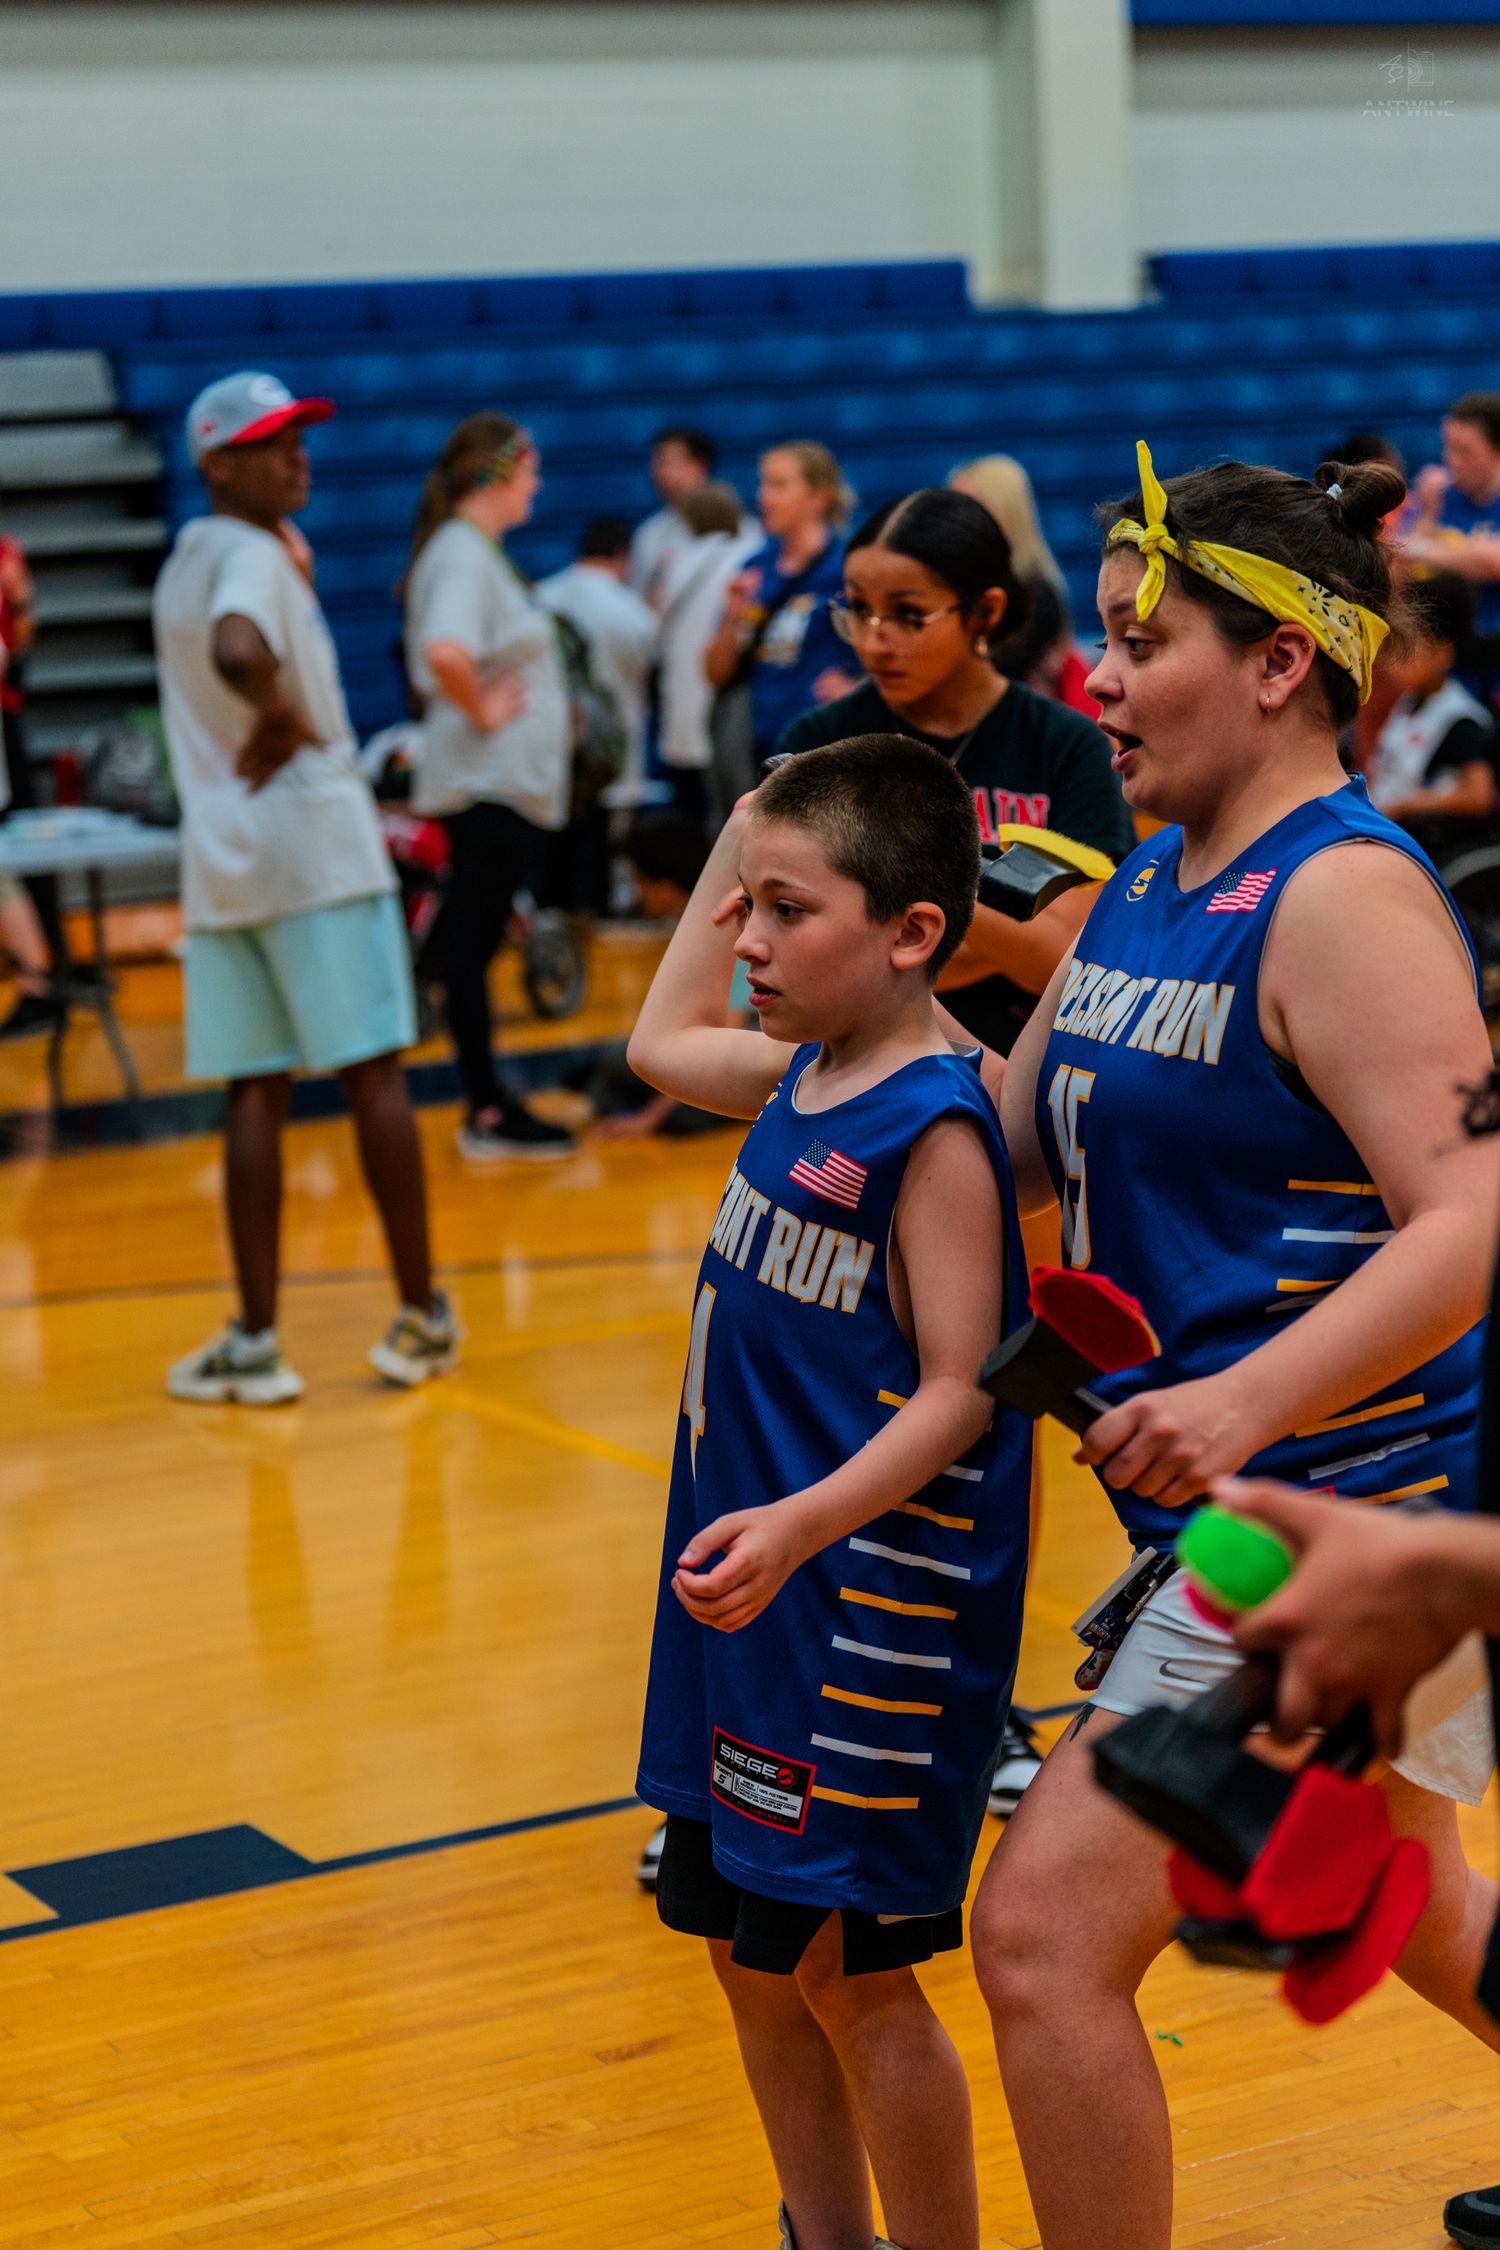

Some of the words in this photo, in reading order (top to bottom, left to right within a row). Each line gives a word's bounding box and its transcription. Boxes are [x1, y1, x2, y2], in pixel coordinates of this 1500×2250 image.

[1126, 979, 1236, 1066] RUN
[757, 1206, 875, 1314] RUN
[718, 1774, 727, 1785] S
[720, 1743, 779, 1779] SIEGE
